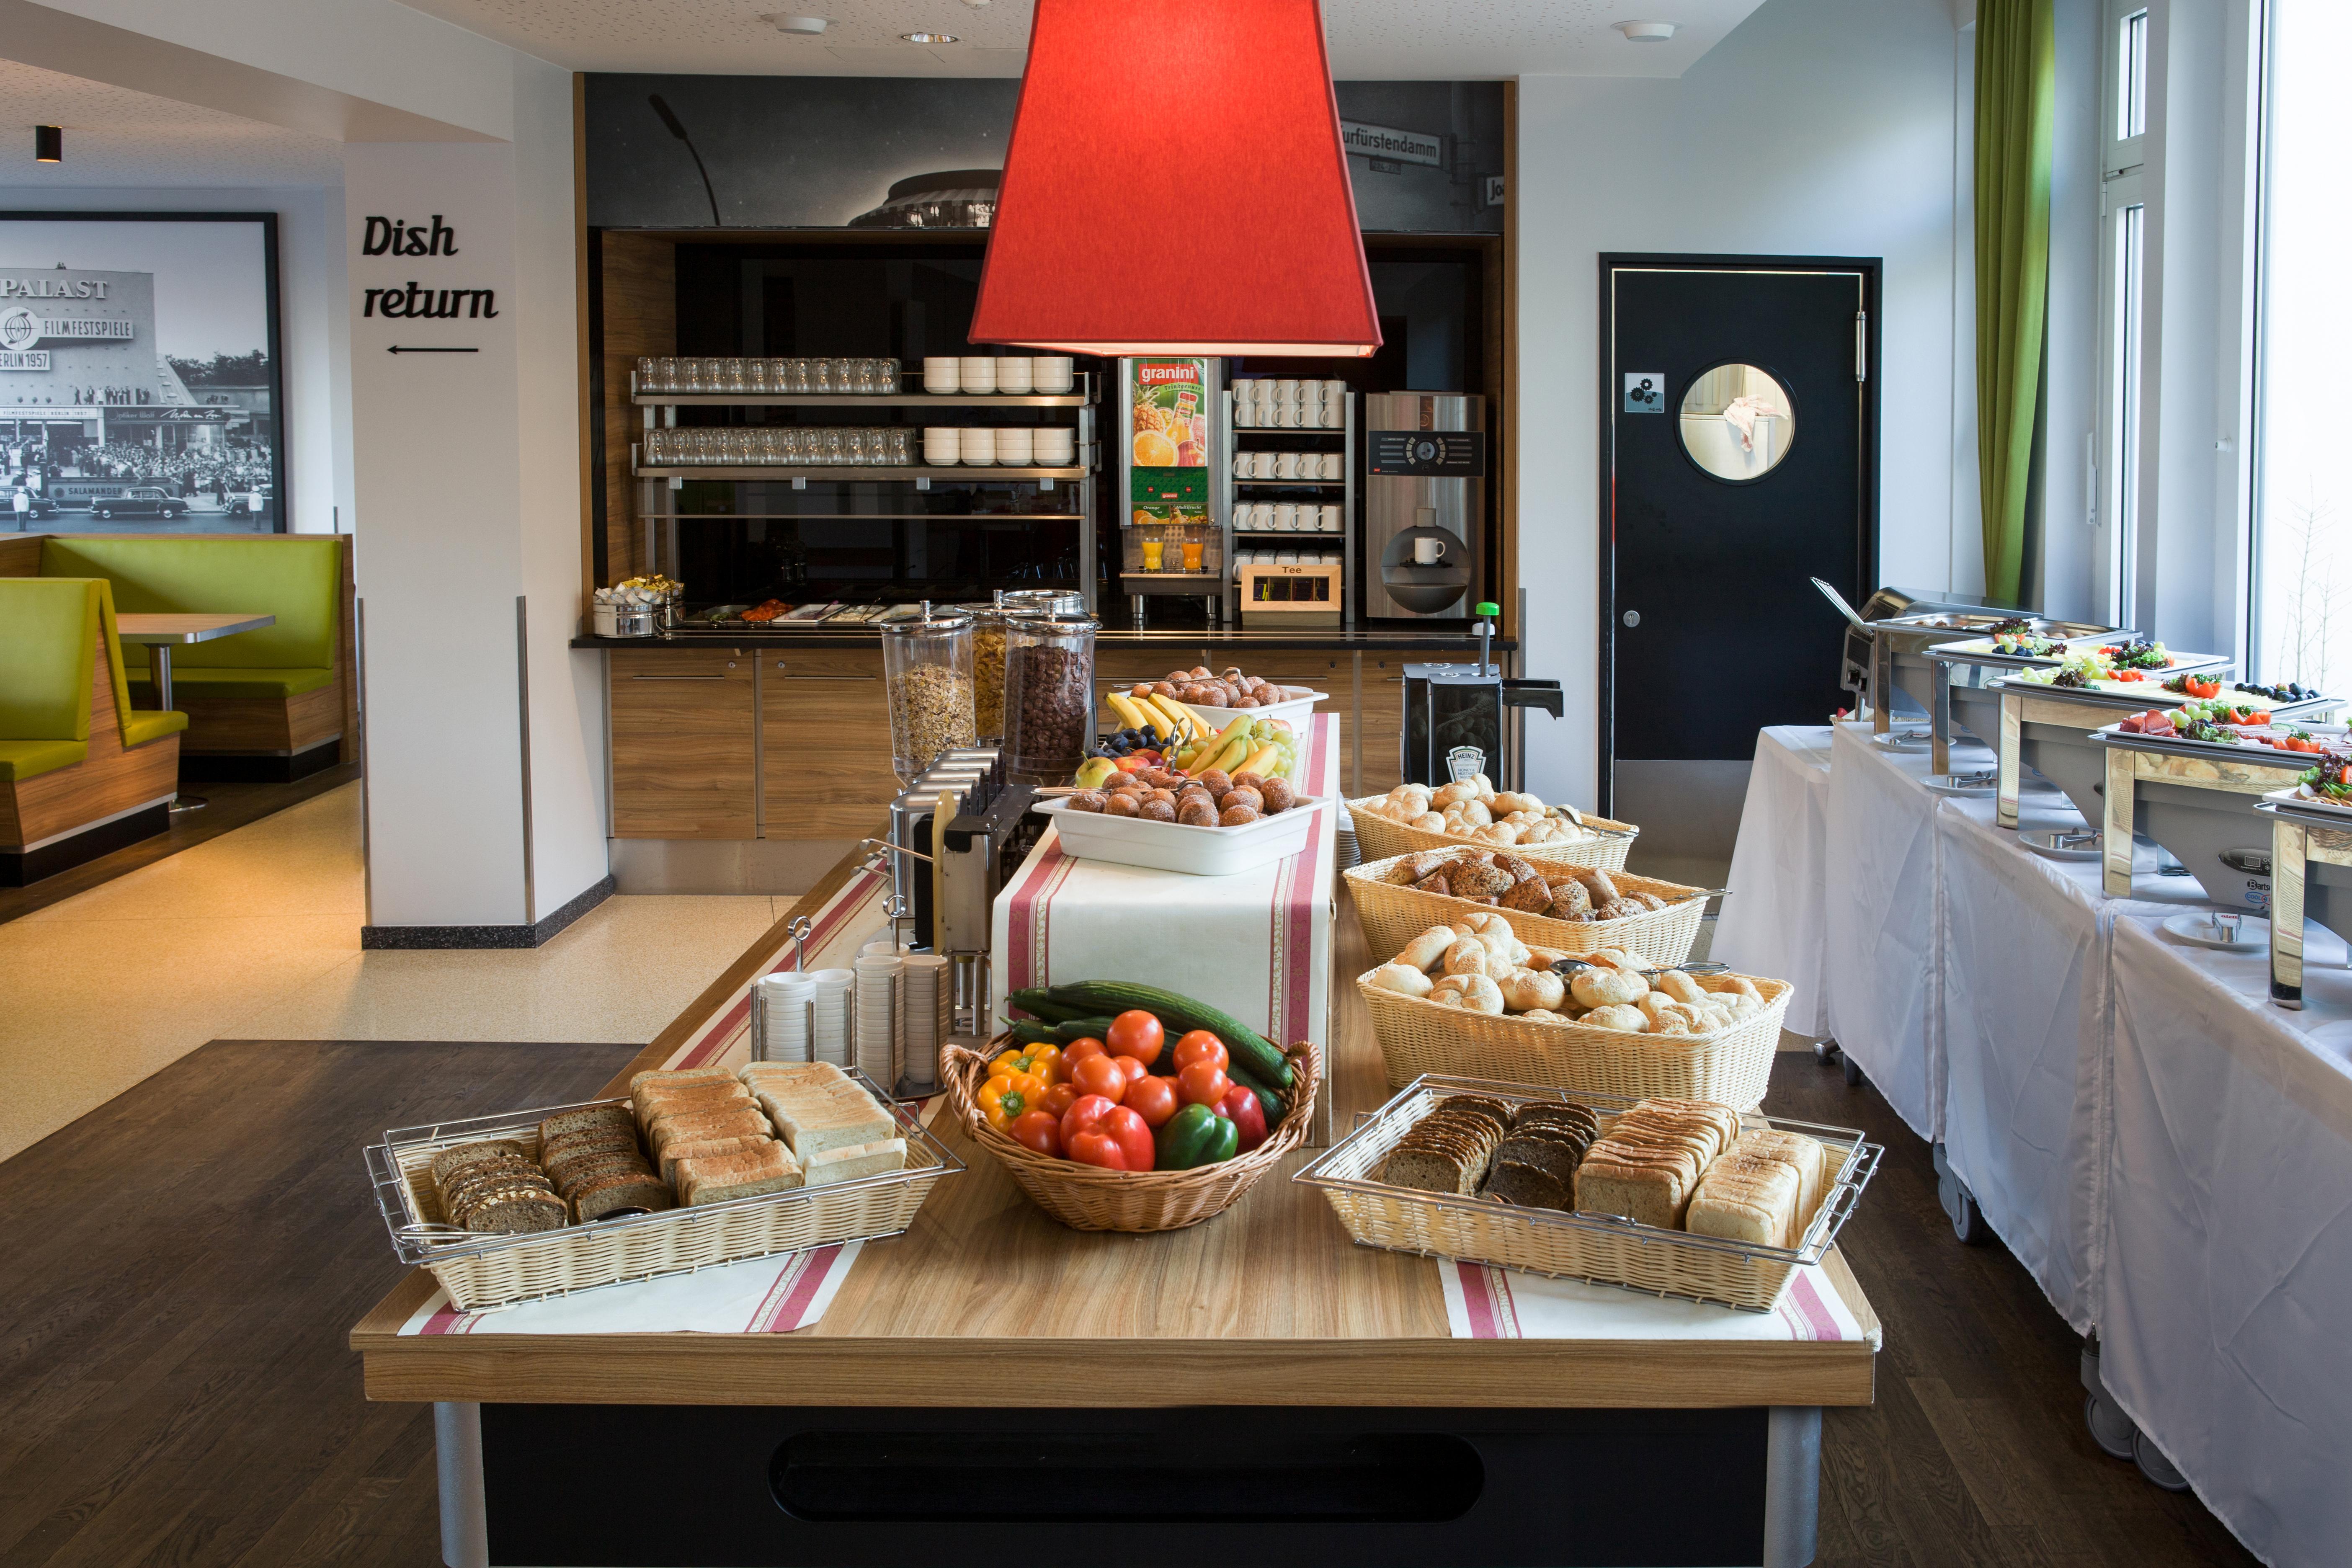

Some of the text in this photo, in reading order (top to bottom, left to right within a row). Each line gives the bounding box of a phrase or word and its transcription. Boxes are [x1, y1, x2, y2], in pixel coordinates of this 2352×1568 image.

[1341, 127, 1436, 157] urfürstendamm
[363, 215, 459, 256] Dish
[0, 279, 108, 299] PALAST
[364, 281, 499, 318] return
[45, 320, 129, 336] FILMFESTSPIELE
[26, 353, 47, 367] 1957
[1142, 366, 1194, 382] granini
